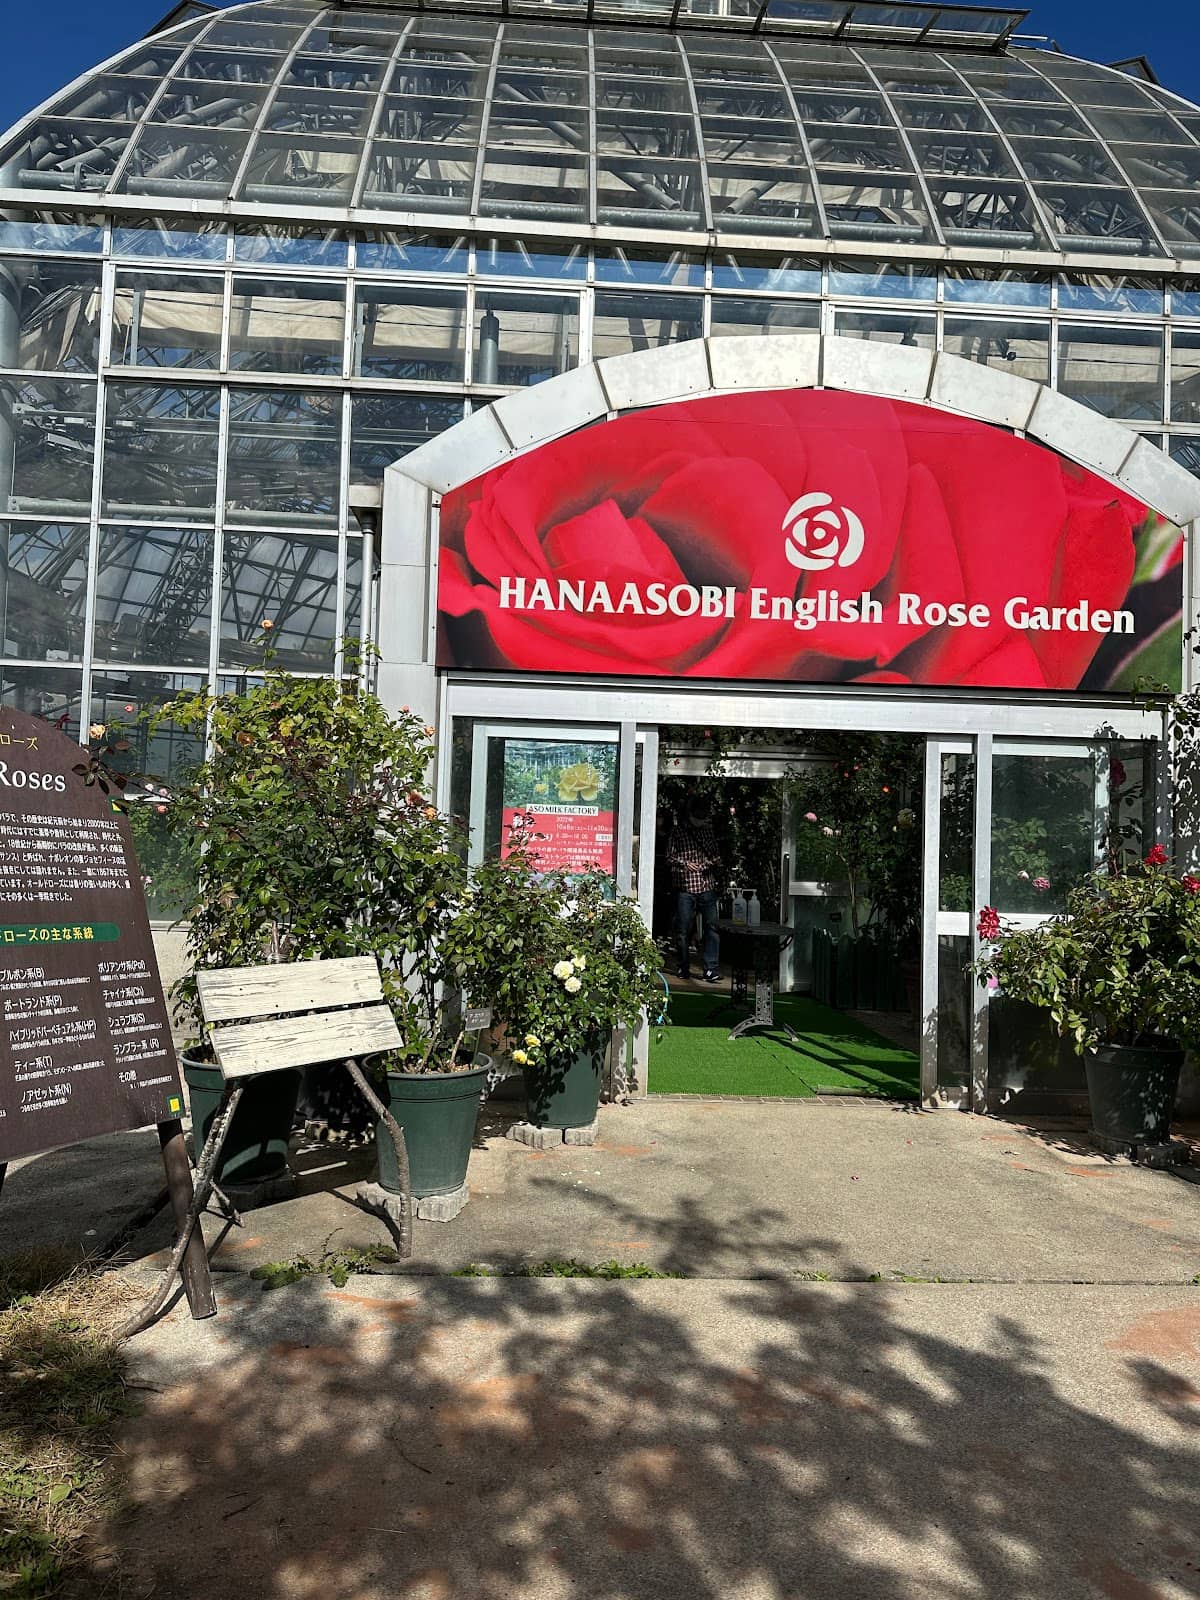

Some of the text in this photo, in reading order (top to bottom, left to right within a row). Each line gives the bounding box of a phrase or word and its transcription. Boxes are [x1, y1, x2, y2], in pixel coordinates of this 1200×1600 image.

[499, 575, 1136, 635] HANAASOBI English Rose Garden
[564, 806, 598, 815] FACTORY
